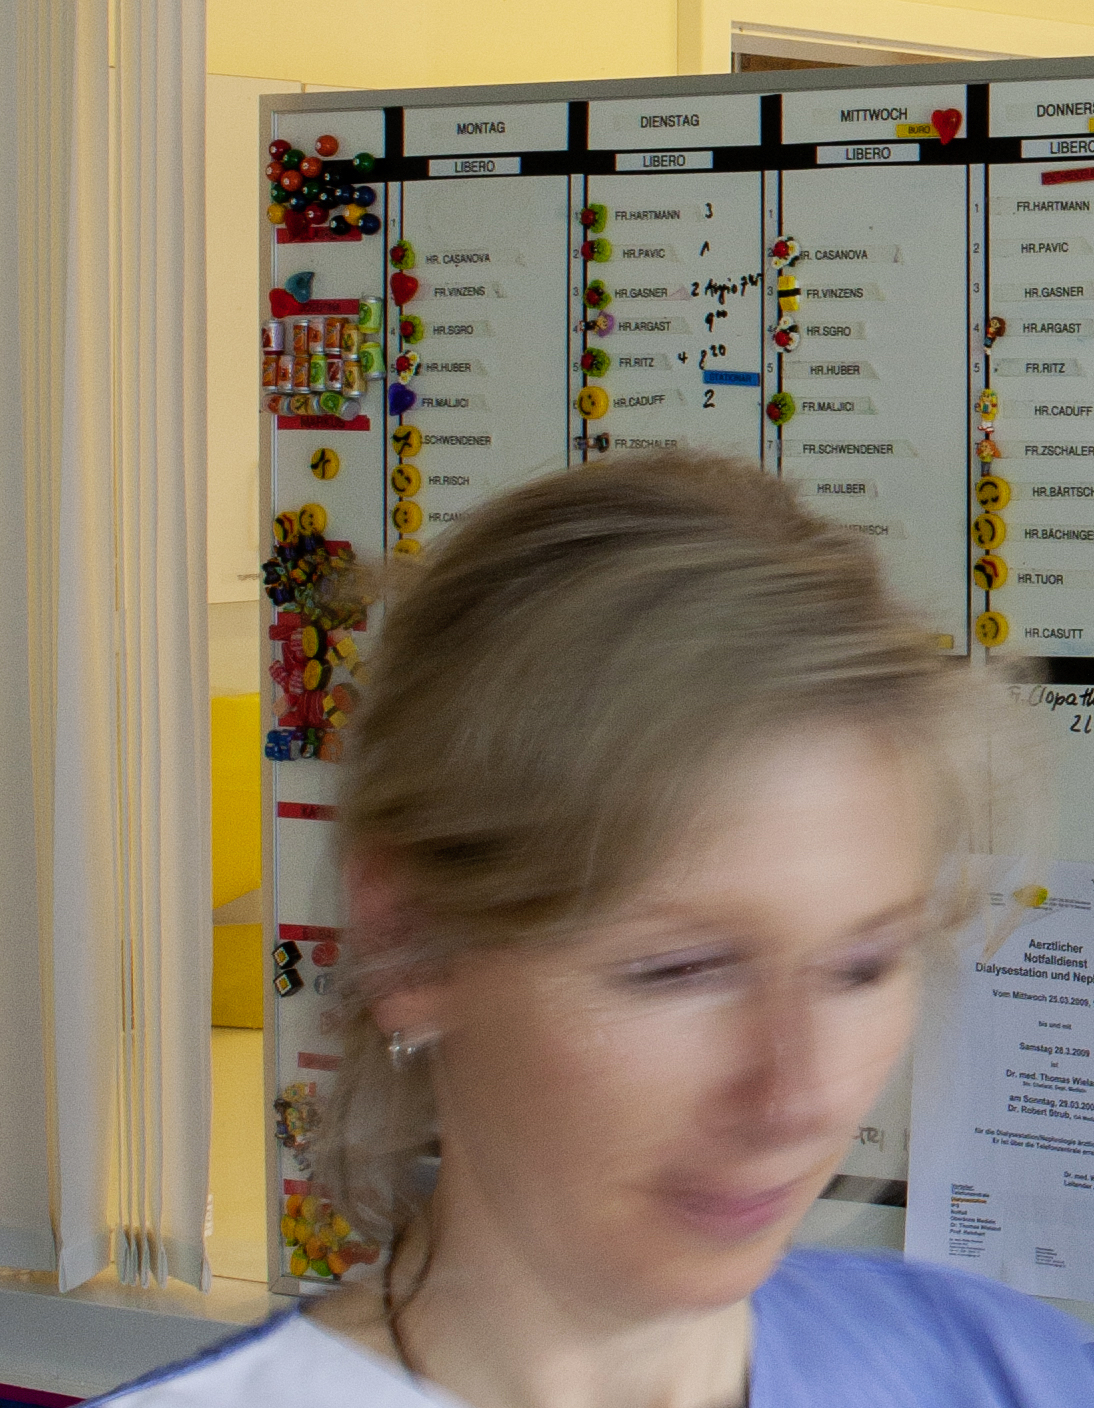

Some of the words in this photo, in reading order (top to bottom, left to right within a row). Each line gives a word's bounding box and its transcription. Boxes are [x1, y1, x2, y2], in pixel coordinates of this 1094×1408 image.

[640, 114, 700, 128] DIENSTAG
[840, 108, 908, 122] MITTWOCH
[457, 122, 506, 134] MONTAG
[845, 147, 891, 160] LIBERO
[454, 160, 495, 173] LIBERO
[642, 155, 686, 168] LIBERO
[705, 202, 714, 219] 3
[1017, 201, 1090, 212] FR.HARTMANN
[615, 210, 680, 221] FR.HARTMANN
[623, 249, 666, 258] HR.PAVIC
[1021, 242, 1069, 253] HR.PAVIC
[443, 253, 491, 264] CASANOVA
[815, 249, 868, 261] CASANOVA
[615, 288, 668, 298] HR.GASNER
[691, 282, 700, 297] 2
[806, 287, 864, 299] FR.VINZENS
[1024, 287, 1084, 299] HR.GASNER
[619, 321, 671, 331] HR.ARGAST
[806, 326, 852, 336] HR.SGRO
[1023, 323, 1082, 333] HR.ARGAST
[619, 357, 654, 368] FR.RITZ
[677, 351, 688, 364] 4
[426, 362, 472, 373] HR.HUBER
[810, 365, 860, 376] HR.HUBER
[1025, 362, 1066, 374] FR.RITZ
[613, 395, 666, 408] HR.CADUFF
[703, 389, 715, 408] 2
[1034, 405, 1093, 416] HR.CADUFF
[422, 435, 492, 446] .SCHWENDENER
[802, 444, 894, 455] FR.SCHWENDENER
[429, 475, 470, 486] HR.RISCH
[817, 483, 866, 494] HR.ULBER
[1017, 573, 1064, 585] HR.TUOR
[1025, 628, 1084, 639] HR.CASUTT
[1028, 938, 1084, 954] Aerztlicher
[1024, 952, 1088, 969] Notfalldienst
[975, 962, 1048, 979] Dialysestation
[1051, 970, 1070, 982] und
